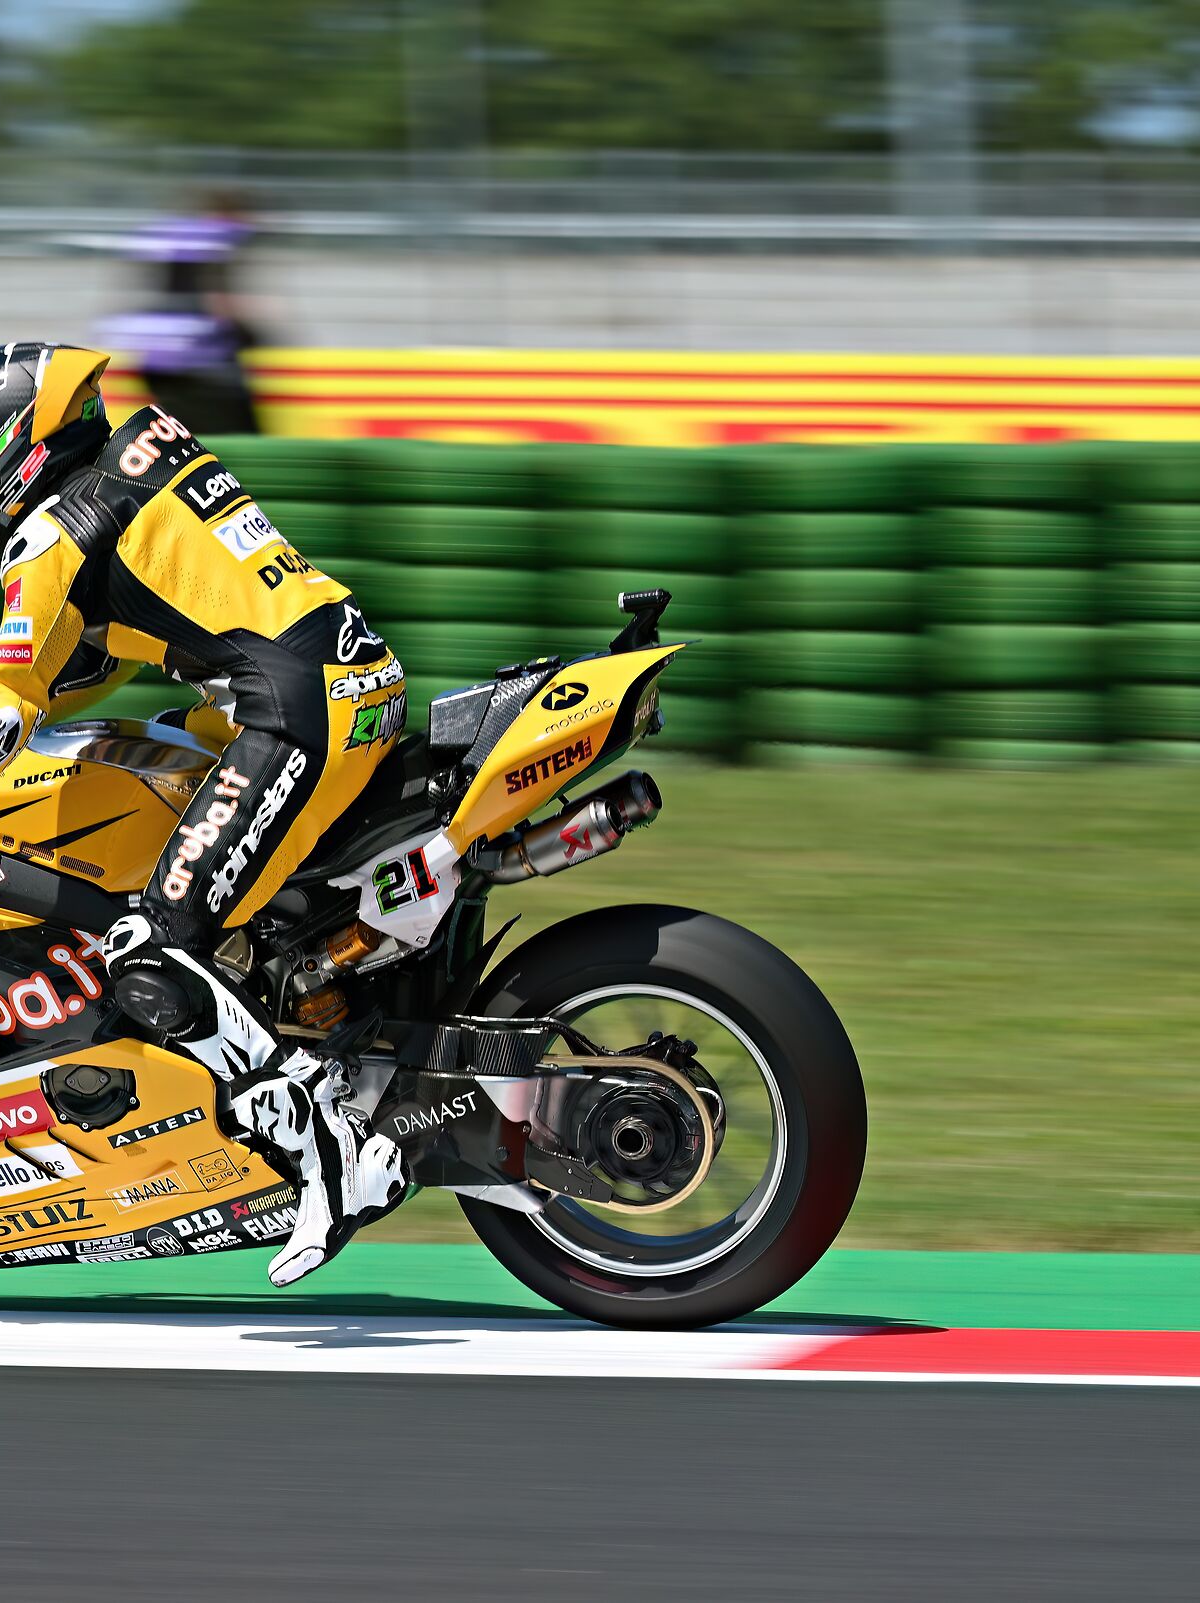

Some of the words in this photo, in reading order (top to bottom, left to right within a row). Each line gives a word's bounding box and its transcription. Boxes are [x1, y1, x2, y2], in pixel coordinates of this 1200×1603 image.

[545, 697, 615, 734] motorola
[13, 764, 81, 790] DUCATI
[162, 765, 250, 901] aruba.it
[207, 748, 307, 914] alpinestars
[372, 846, 439, 916] 21
[115, 1109, 202, 1147] ALTEN
[393, 1090, 479, 1136] DAMAST
[113, 1177, 180, 1207] UMANA
[13, 1242, 71, 1263] FERVI
[151, 1236, 181, 1253] STM
[187, 1228, 238, 1251] NGK
